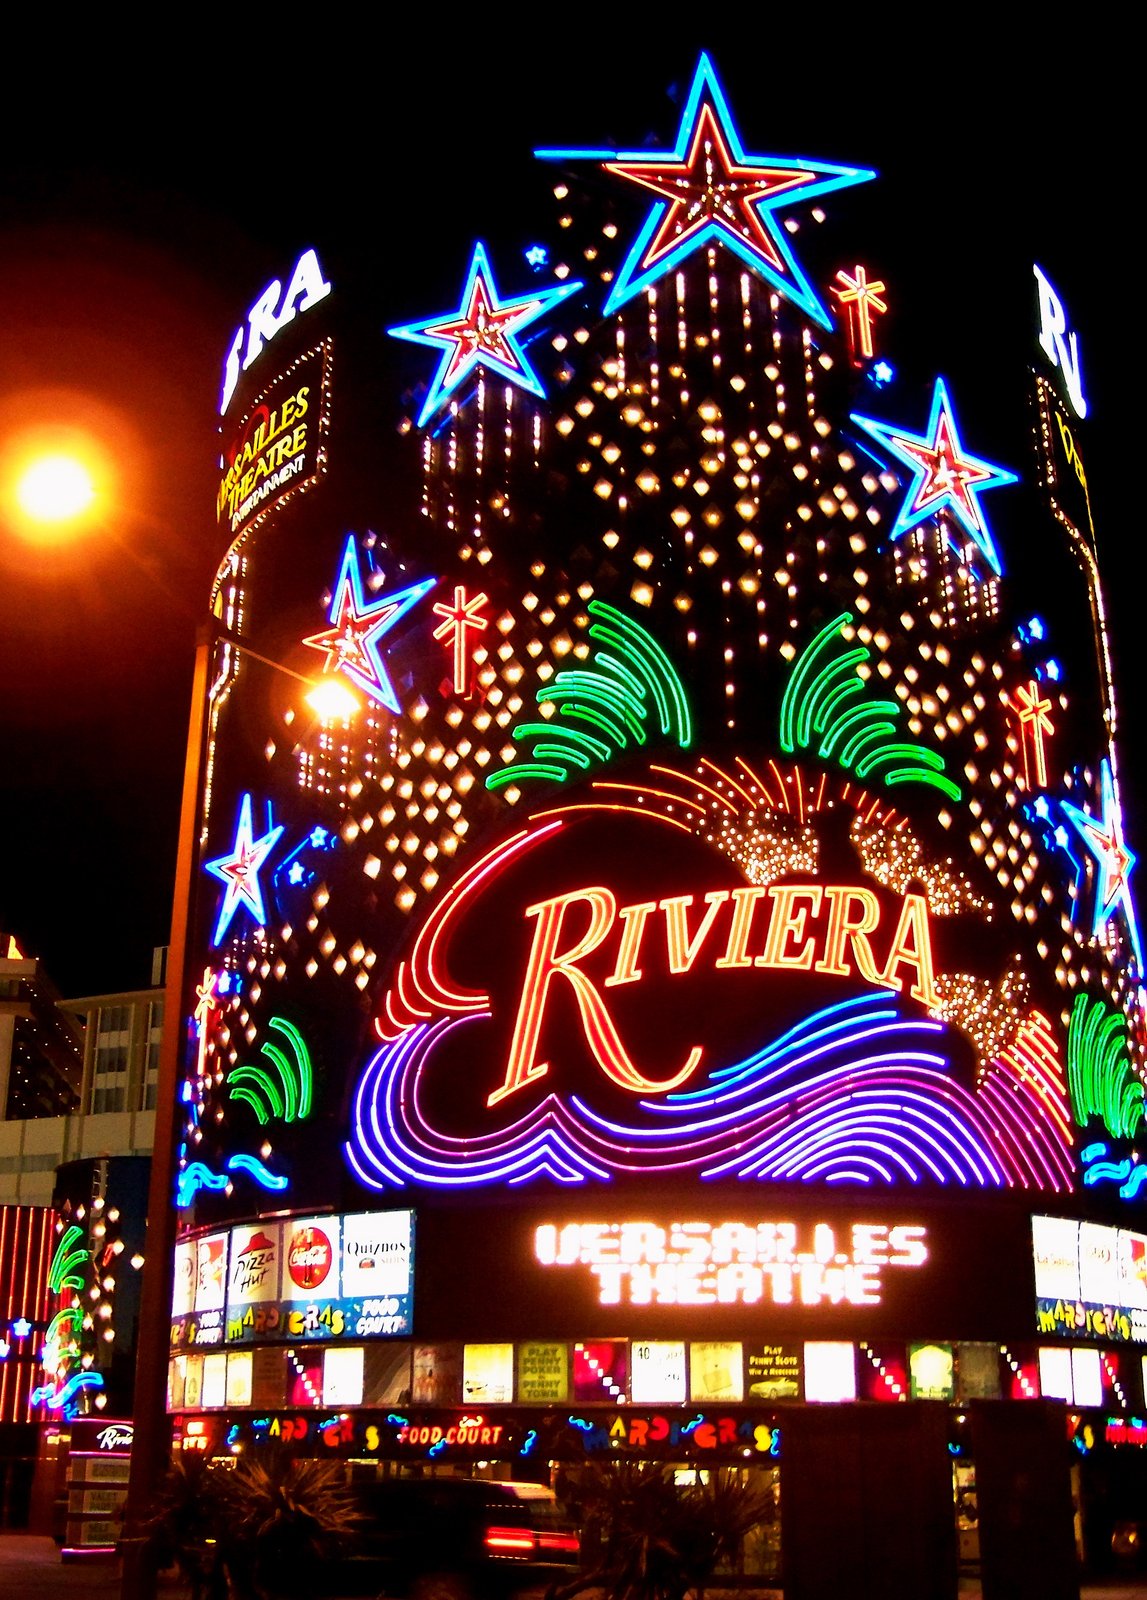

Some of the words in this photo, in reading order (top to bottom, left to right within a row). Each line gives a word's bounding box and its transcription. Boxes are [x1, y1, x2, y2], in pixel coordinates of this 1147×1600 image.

[227, 422, 308, 520] THEATRE
[486, 885, 943, 1107] RIVIERA
[240, 1267, 270, 1293] Hut
[288, 1304, 346, 1337] GRAS
[322, 1416, 381, 1451] GRS
[399, 1425, 442, 1445] FOOD
[445, 1425, 503, 1446] COURT
